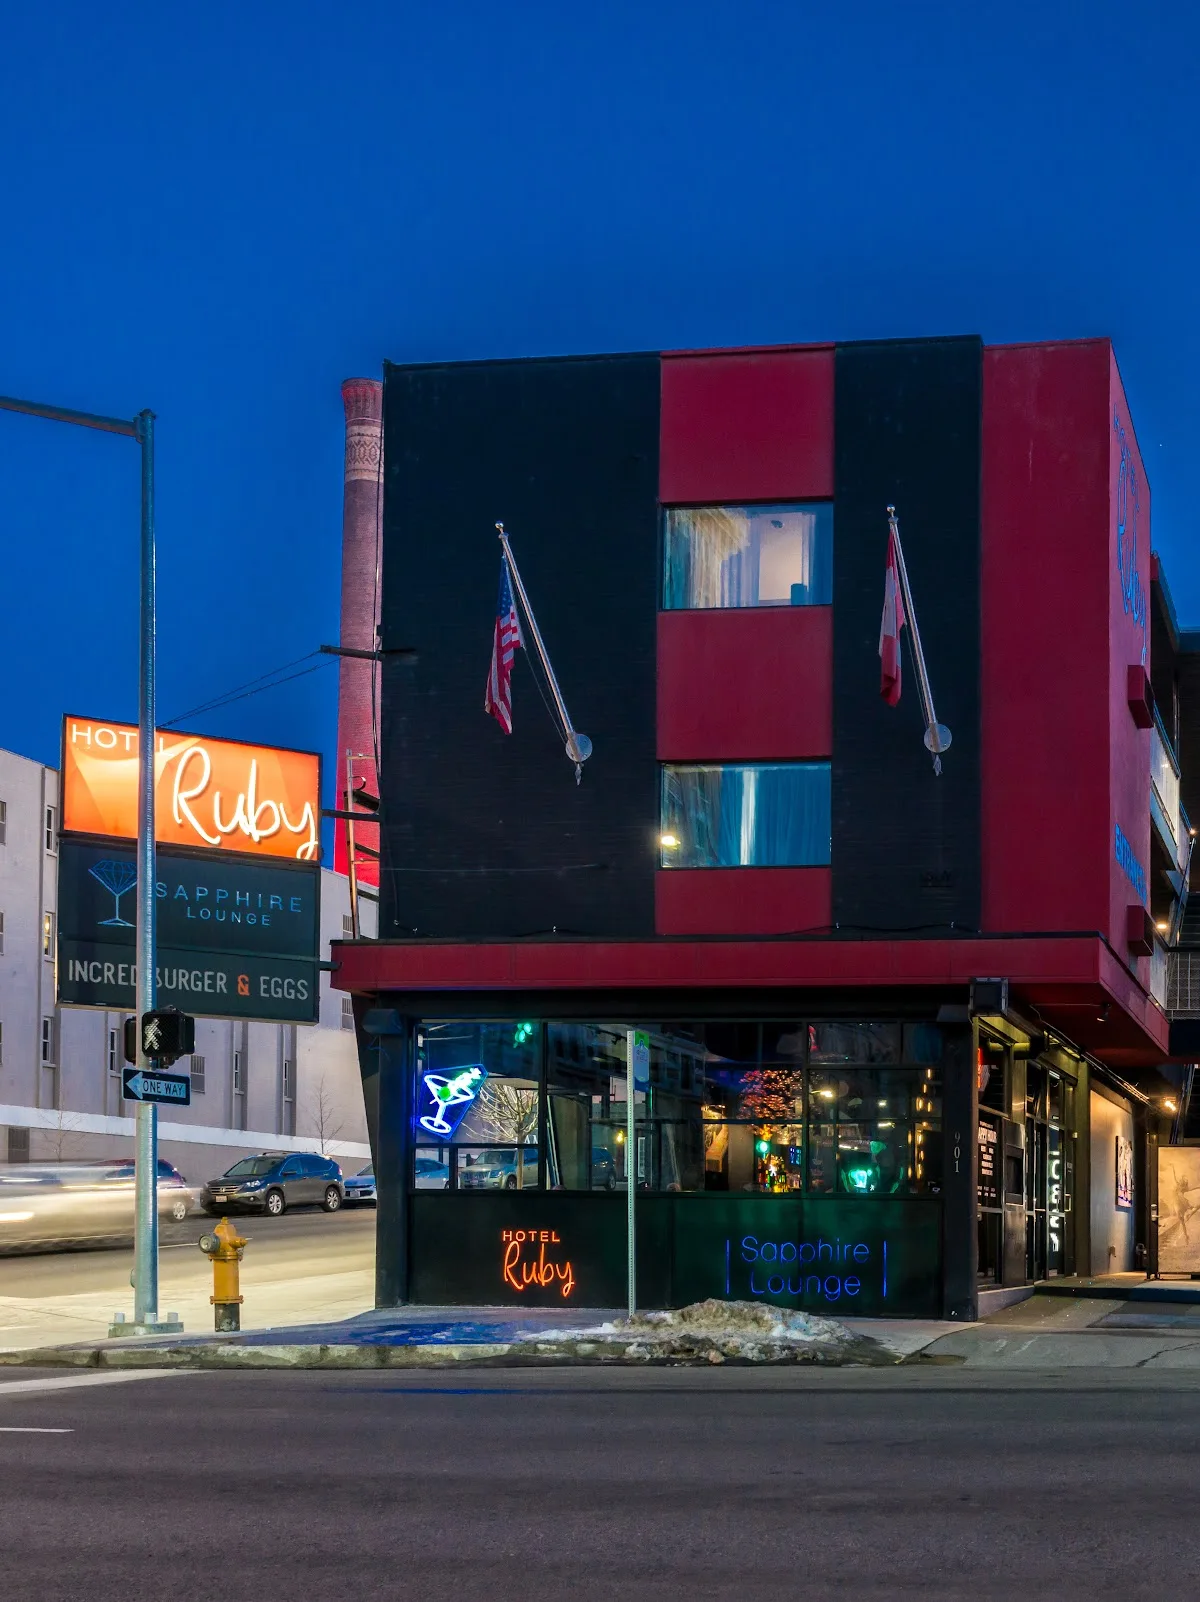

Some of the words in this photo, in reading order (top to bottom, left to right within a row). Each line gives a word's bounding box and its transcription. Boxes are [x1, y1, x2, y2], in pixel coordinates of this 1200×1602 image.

[71, 723, 176, 757] HOTL
[172, 746, 319, 860] Ruby
[155, 882, 302, 913] SAPPHIRE
[186, 906, 271, 926] LOUNGE
[68, 959, 228, 994] INCREDBURGER
[237, 974, 250, 996] &
[260, 975, 309, 1000] EGGS
[142, 1080, 162, 1093] ONE
[164, 1083, 183, 1096] WAY
[502, 1230, 561, 1242] HOTEL
[741, 1235, 870, 1268] Sapphire
[503, 1240, 575, 1297] Ruby
[750, 1270, 861, 1301] Lounge
